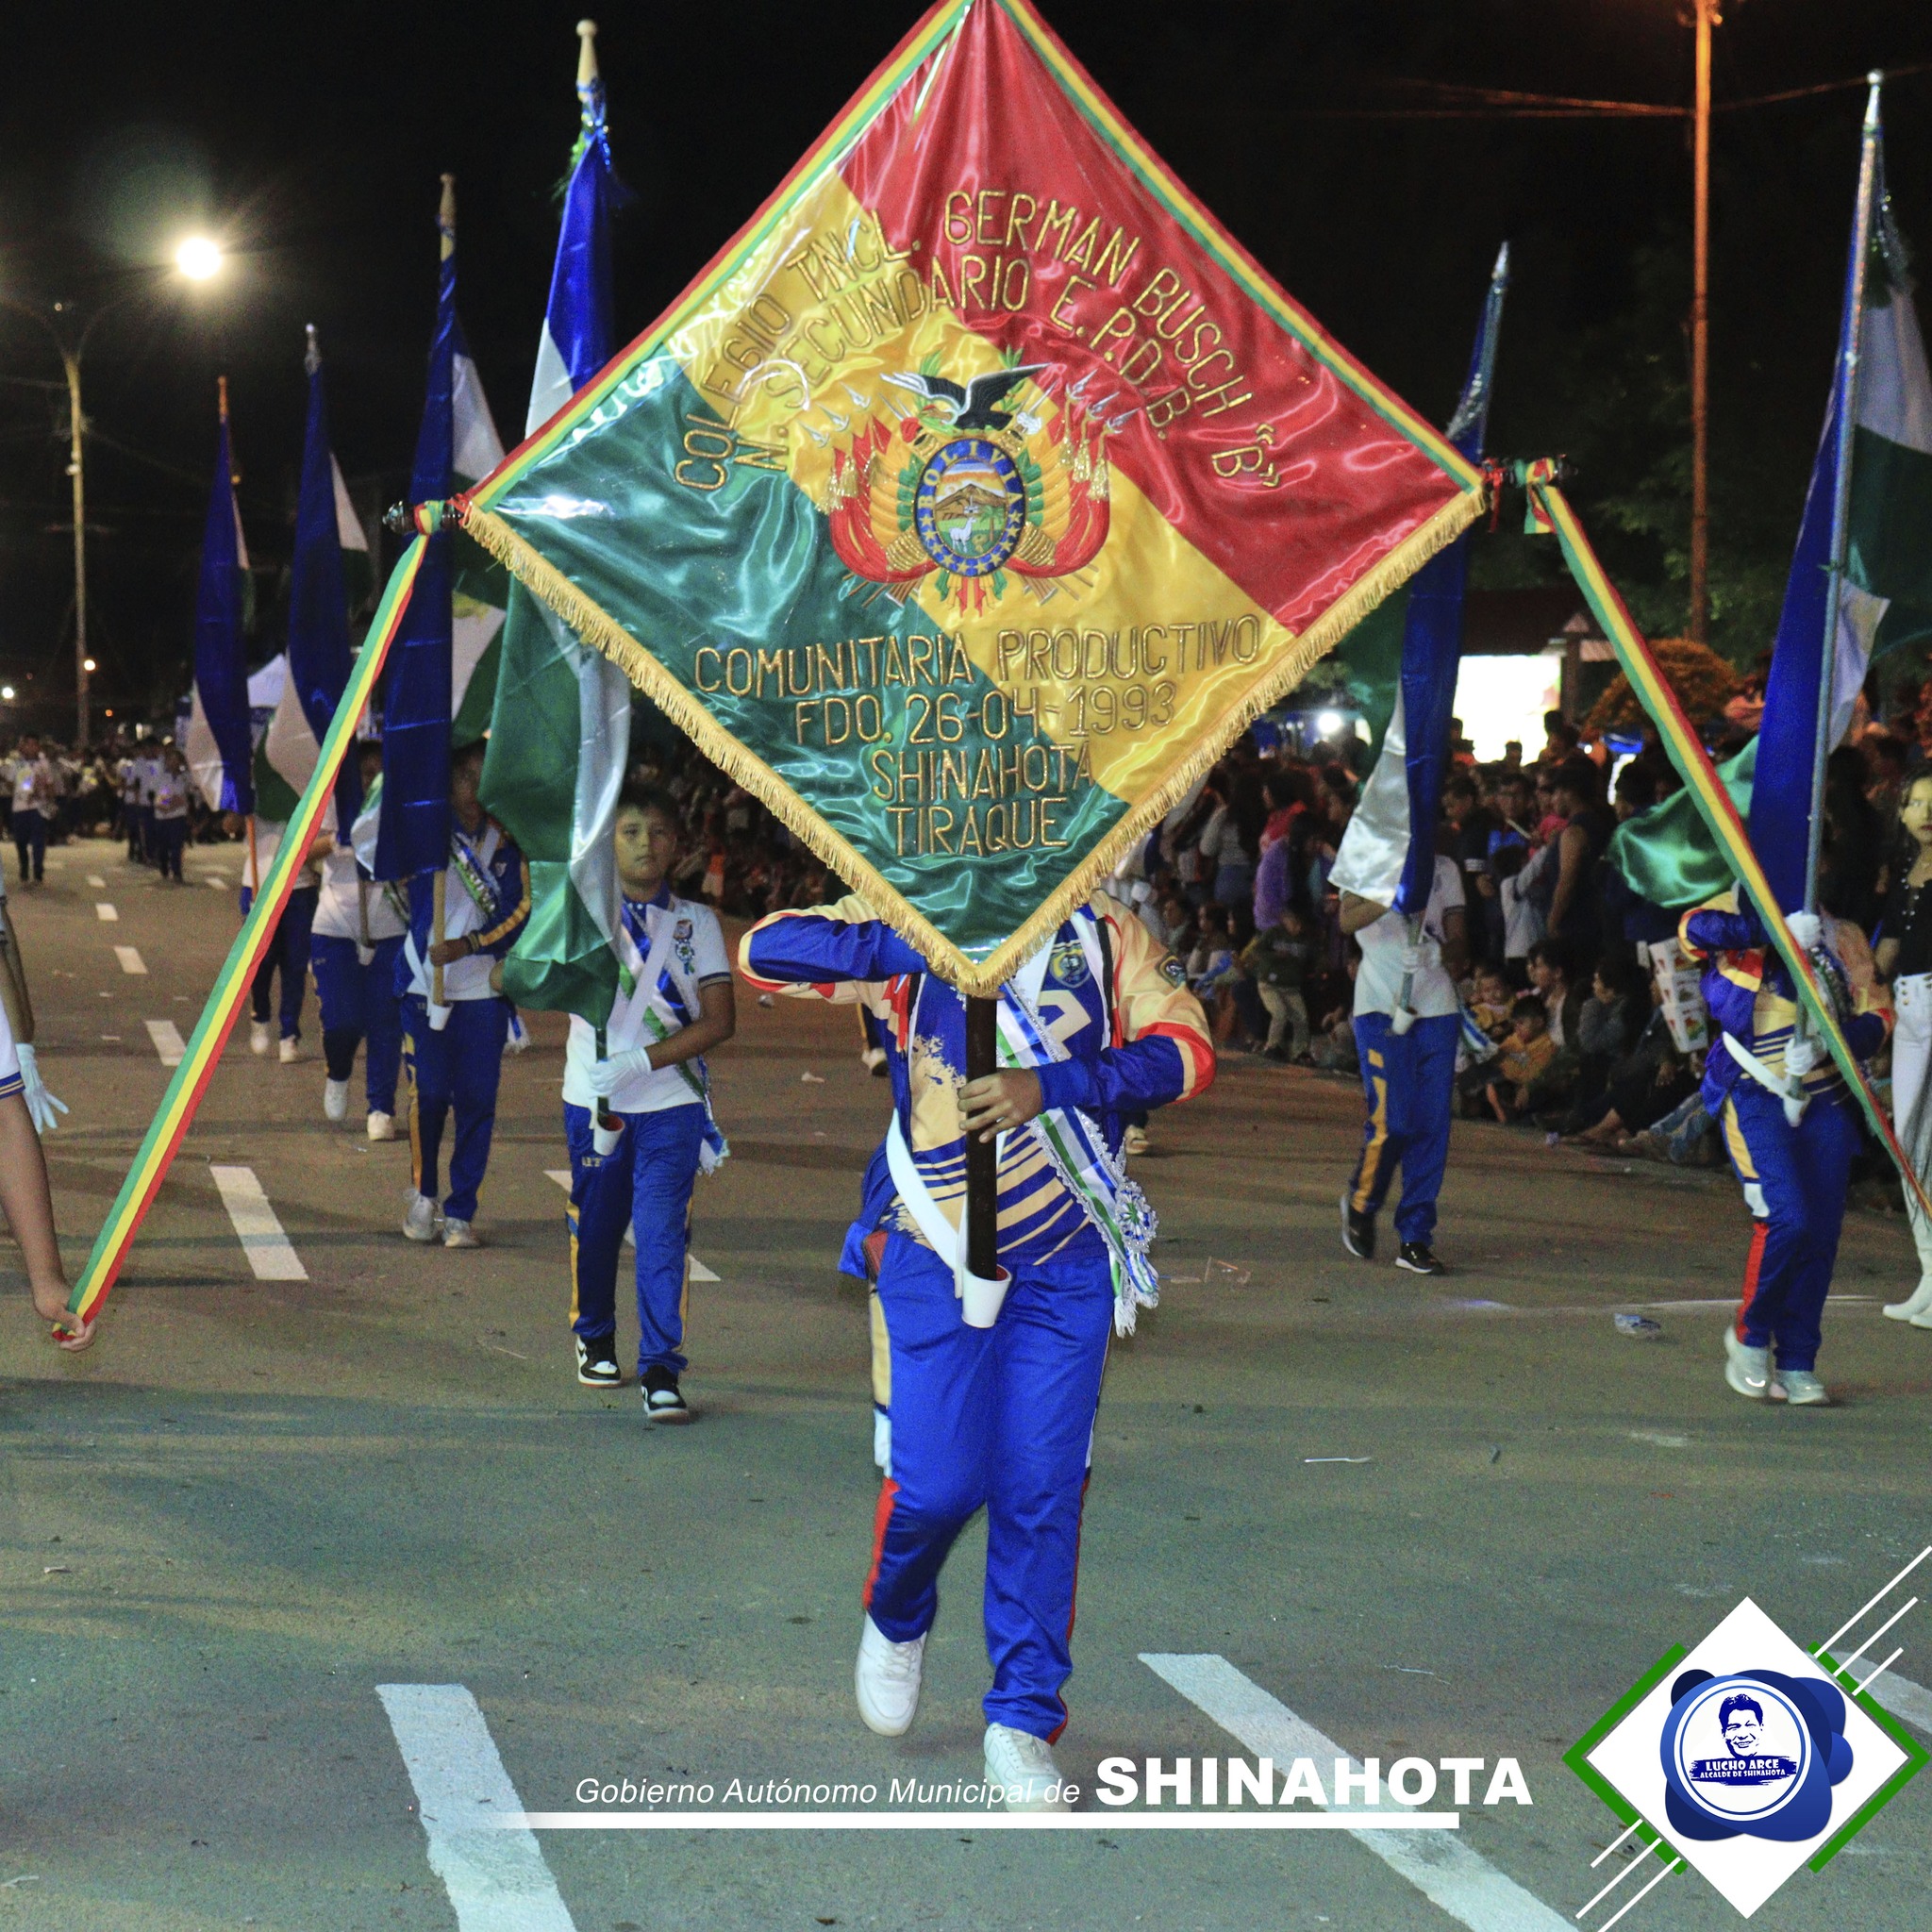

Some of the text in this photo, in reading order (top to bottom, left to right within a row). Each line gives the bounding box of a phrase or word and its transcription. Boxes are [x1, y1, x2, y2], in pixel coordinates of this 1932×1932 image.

[762, 255, 1031, 409] SECUNDARIO
[943, 190, 1140, 287] GERMAN
[1132, 267, 1253, 417] BUSCH
[918, 441, 1024, 509] BOLIVIA
[694, 614, 1260, 698] COMUNITARIA PRODUCTIVO
[794, 694, 892, 745] FDO.
[871, 741, 1095, 802] SHINAHOTA
[885, 797, 1068, 857] TIRAQUE
